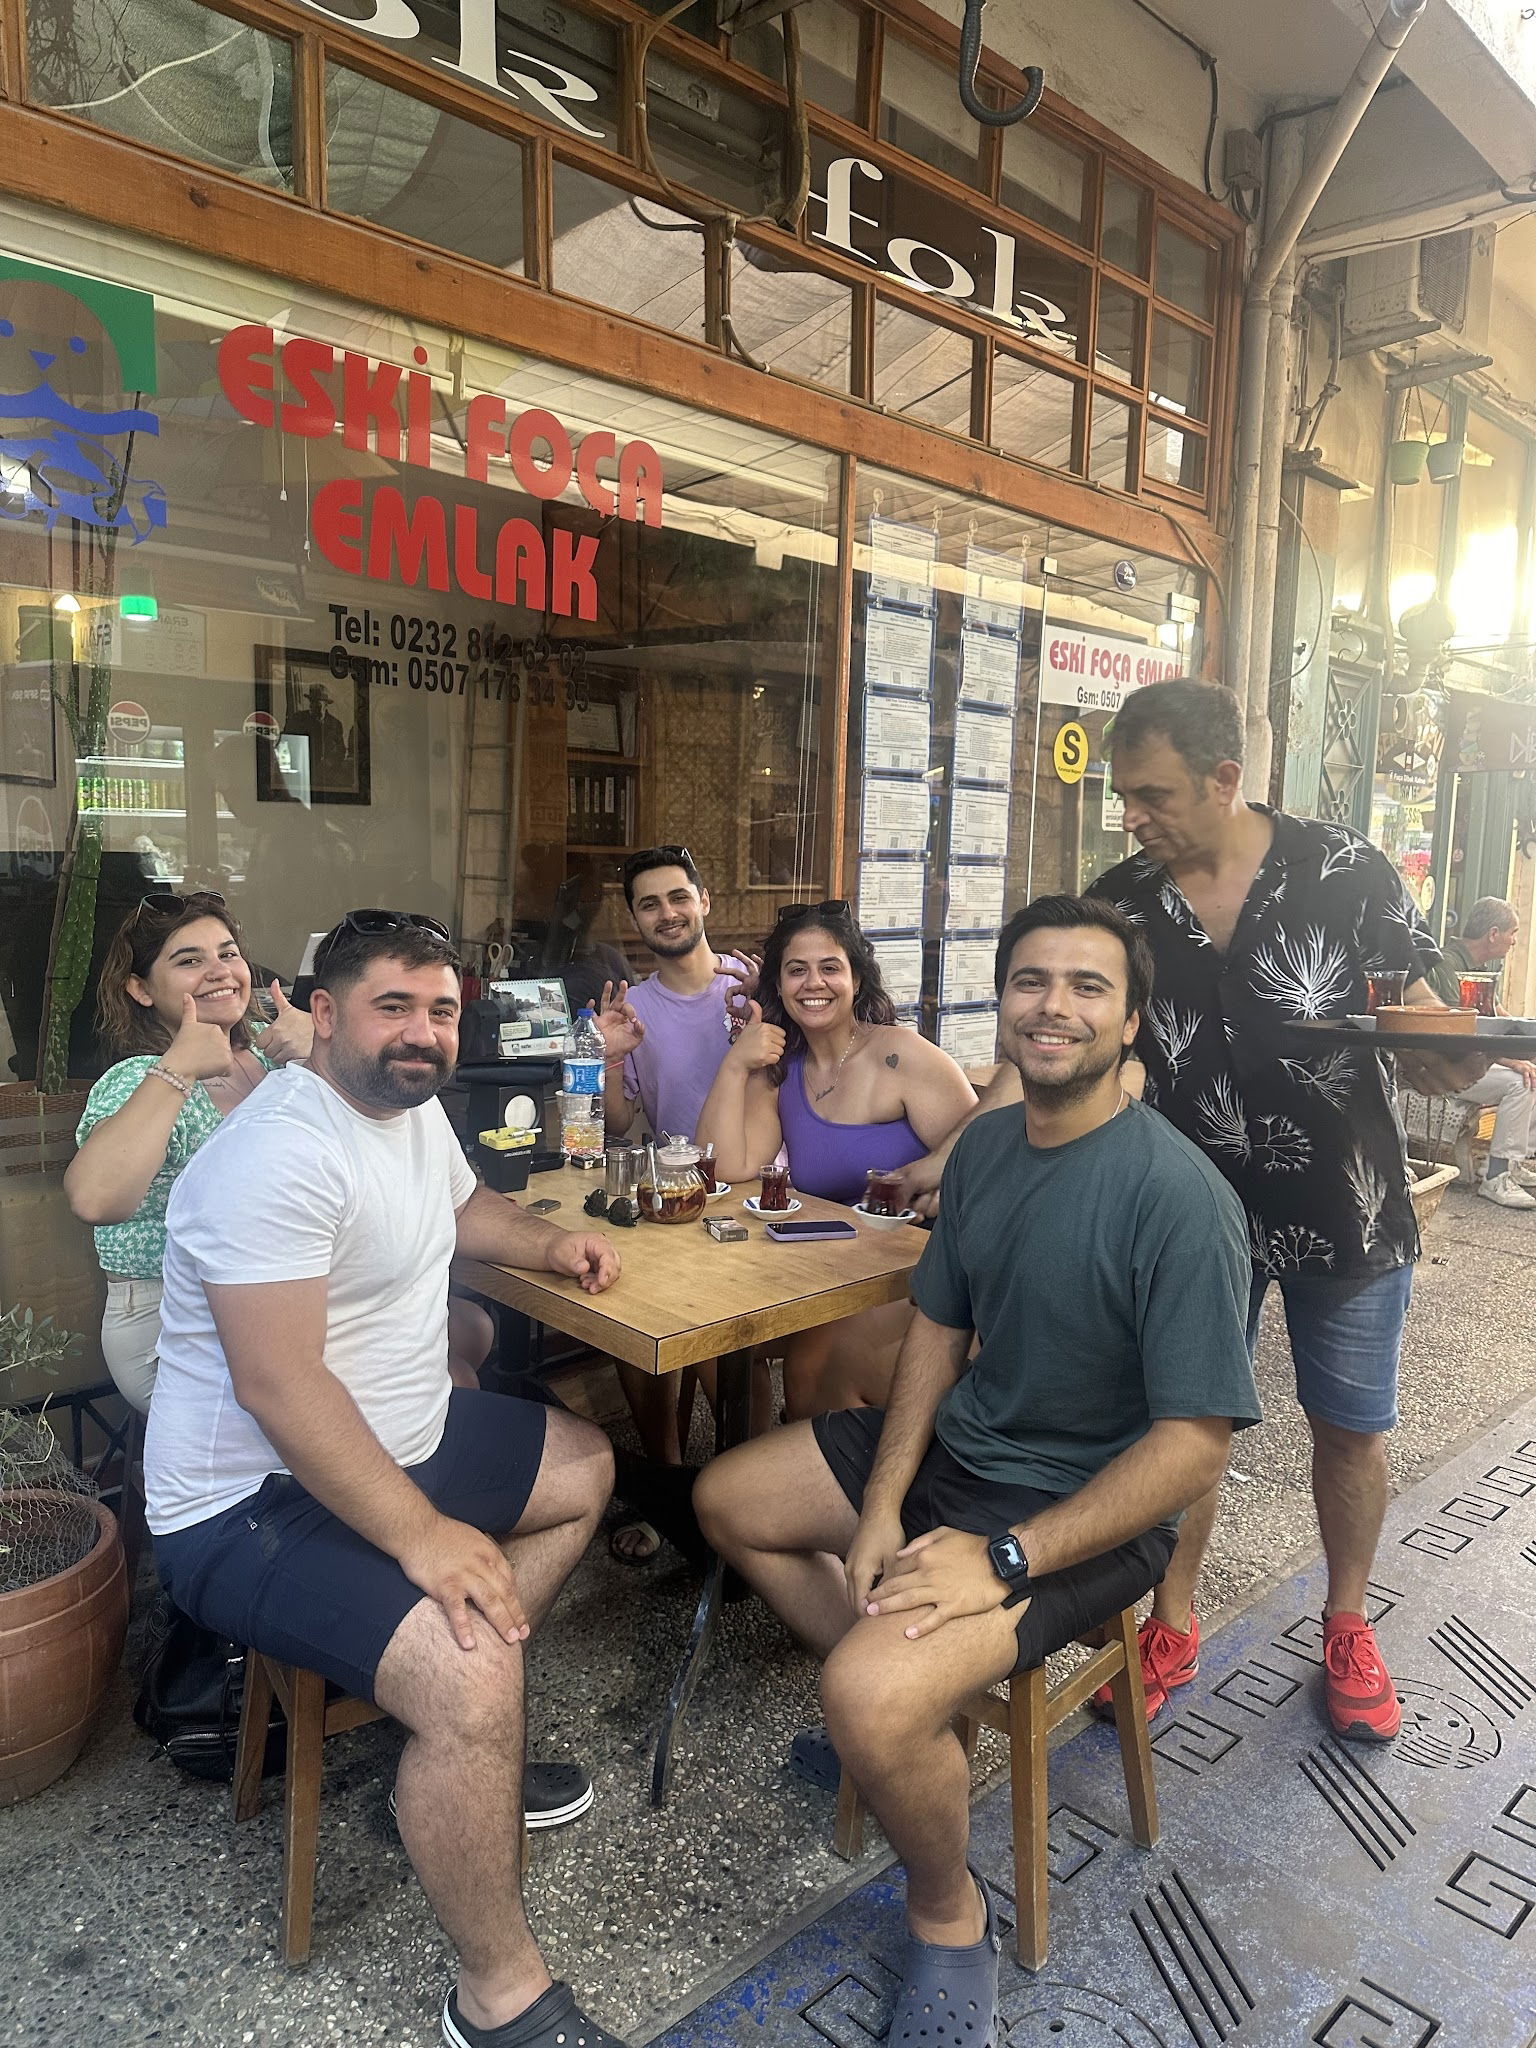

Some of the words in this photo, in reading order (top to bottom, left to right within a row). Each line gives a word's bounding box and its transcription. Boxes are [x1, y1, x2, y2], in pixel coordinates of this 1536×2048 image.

[808, 156, 1077, 346] fok
[217, 325, 432, 469] ESKİ
[466, 394, 663, 529] FOÇA
[312, 478, 598, 622] EMLAK
[329, 602, 380, 648] Tel:
[390, 614, 457, 659] 0232
[467, 627, 513, 666] 812
[522, 637, 550, 672] 62
[1050, 636, 1085, 675] ESKİ
[1091, 647, 1131, 689] FOÇA
[329, 645, 399, 688] Gsm:
[408, 656, 469, 695] 0507
[479, 667, 521, 704] 176
[1077, 686, 1099, 705] Gsm:
[1100, 690, 1121, 709] 0507
[1062, 729, 1081, 766] S
